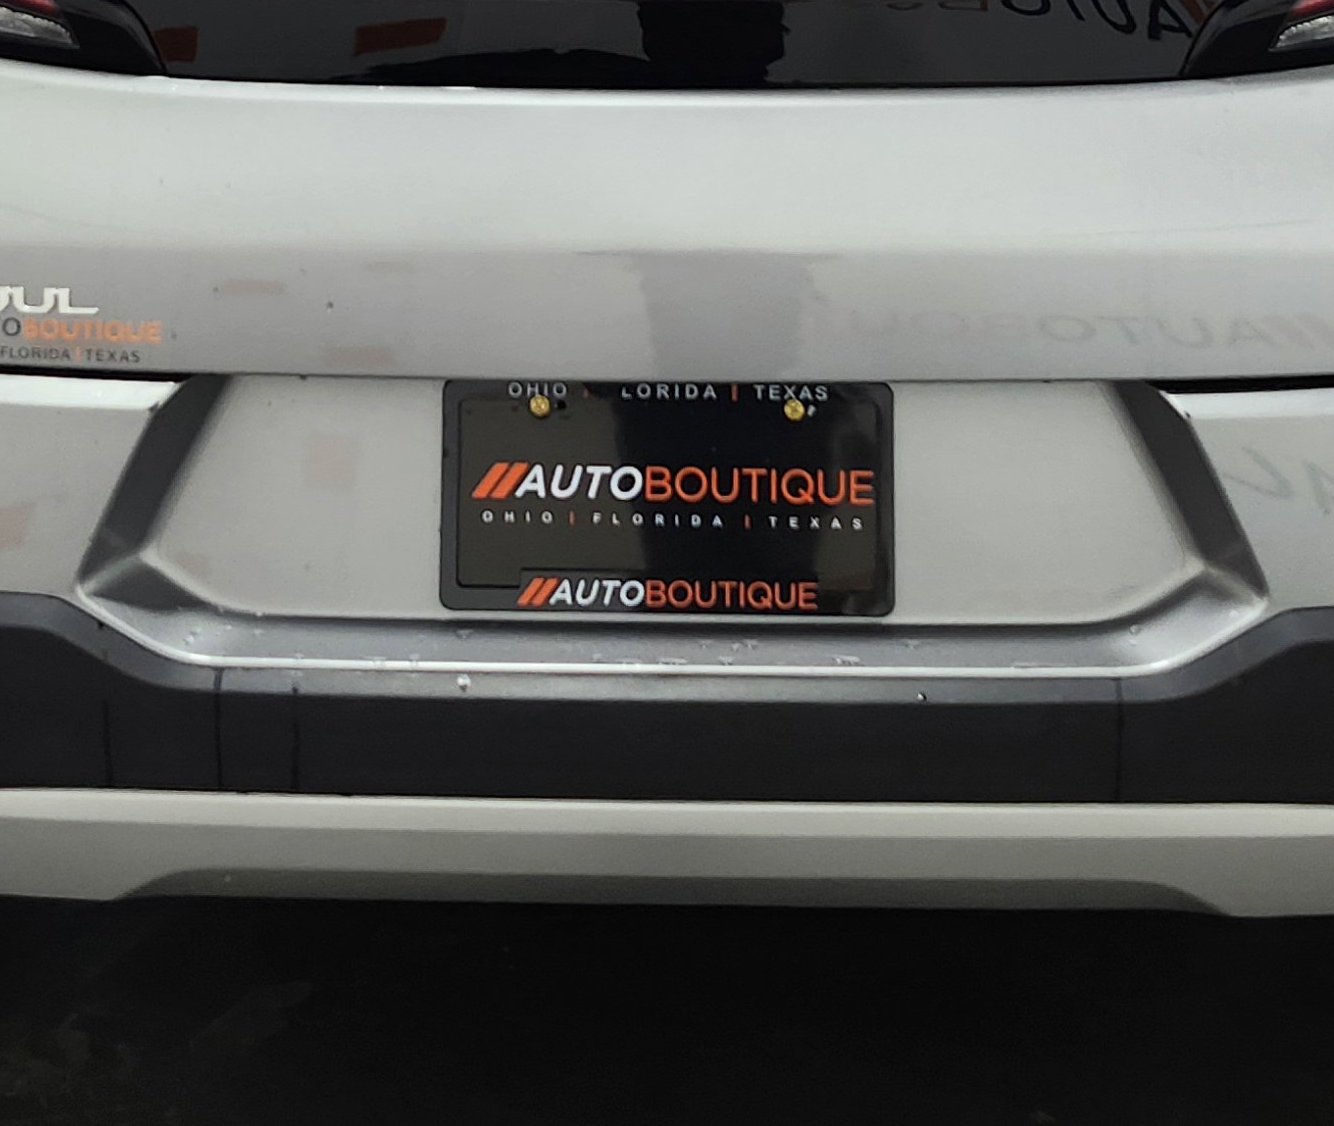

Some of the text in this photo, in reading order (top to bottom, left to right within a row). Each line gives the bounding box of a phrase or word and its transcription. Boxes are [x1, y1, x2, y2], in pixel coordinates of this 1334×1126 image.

[0, 345, 71, 361] FLORIDA
[85, 348, 141, 363] TEXAS
[509, 382, 828, 401] OHIO LORIDA TEXAS
[481, 511, 863, 531] OHIO FLORIDA TEXAS
